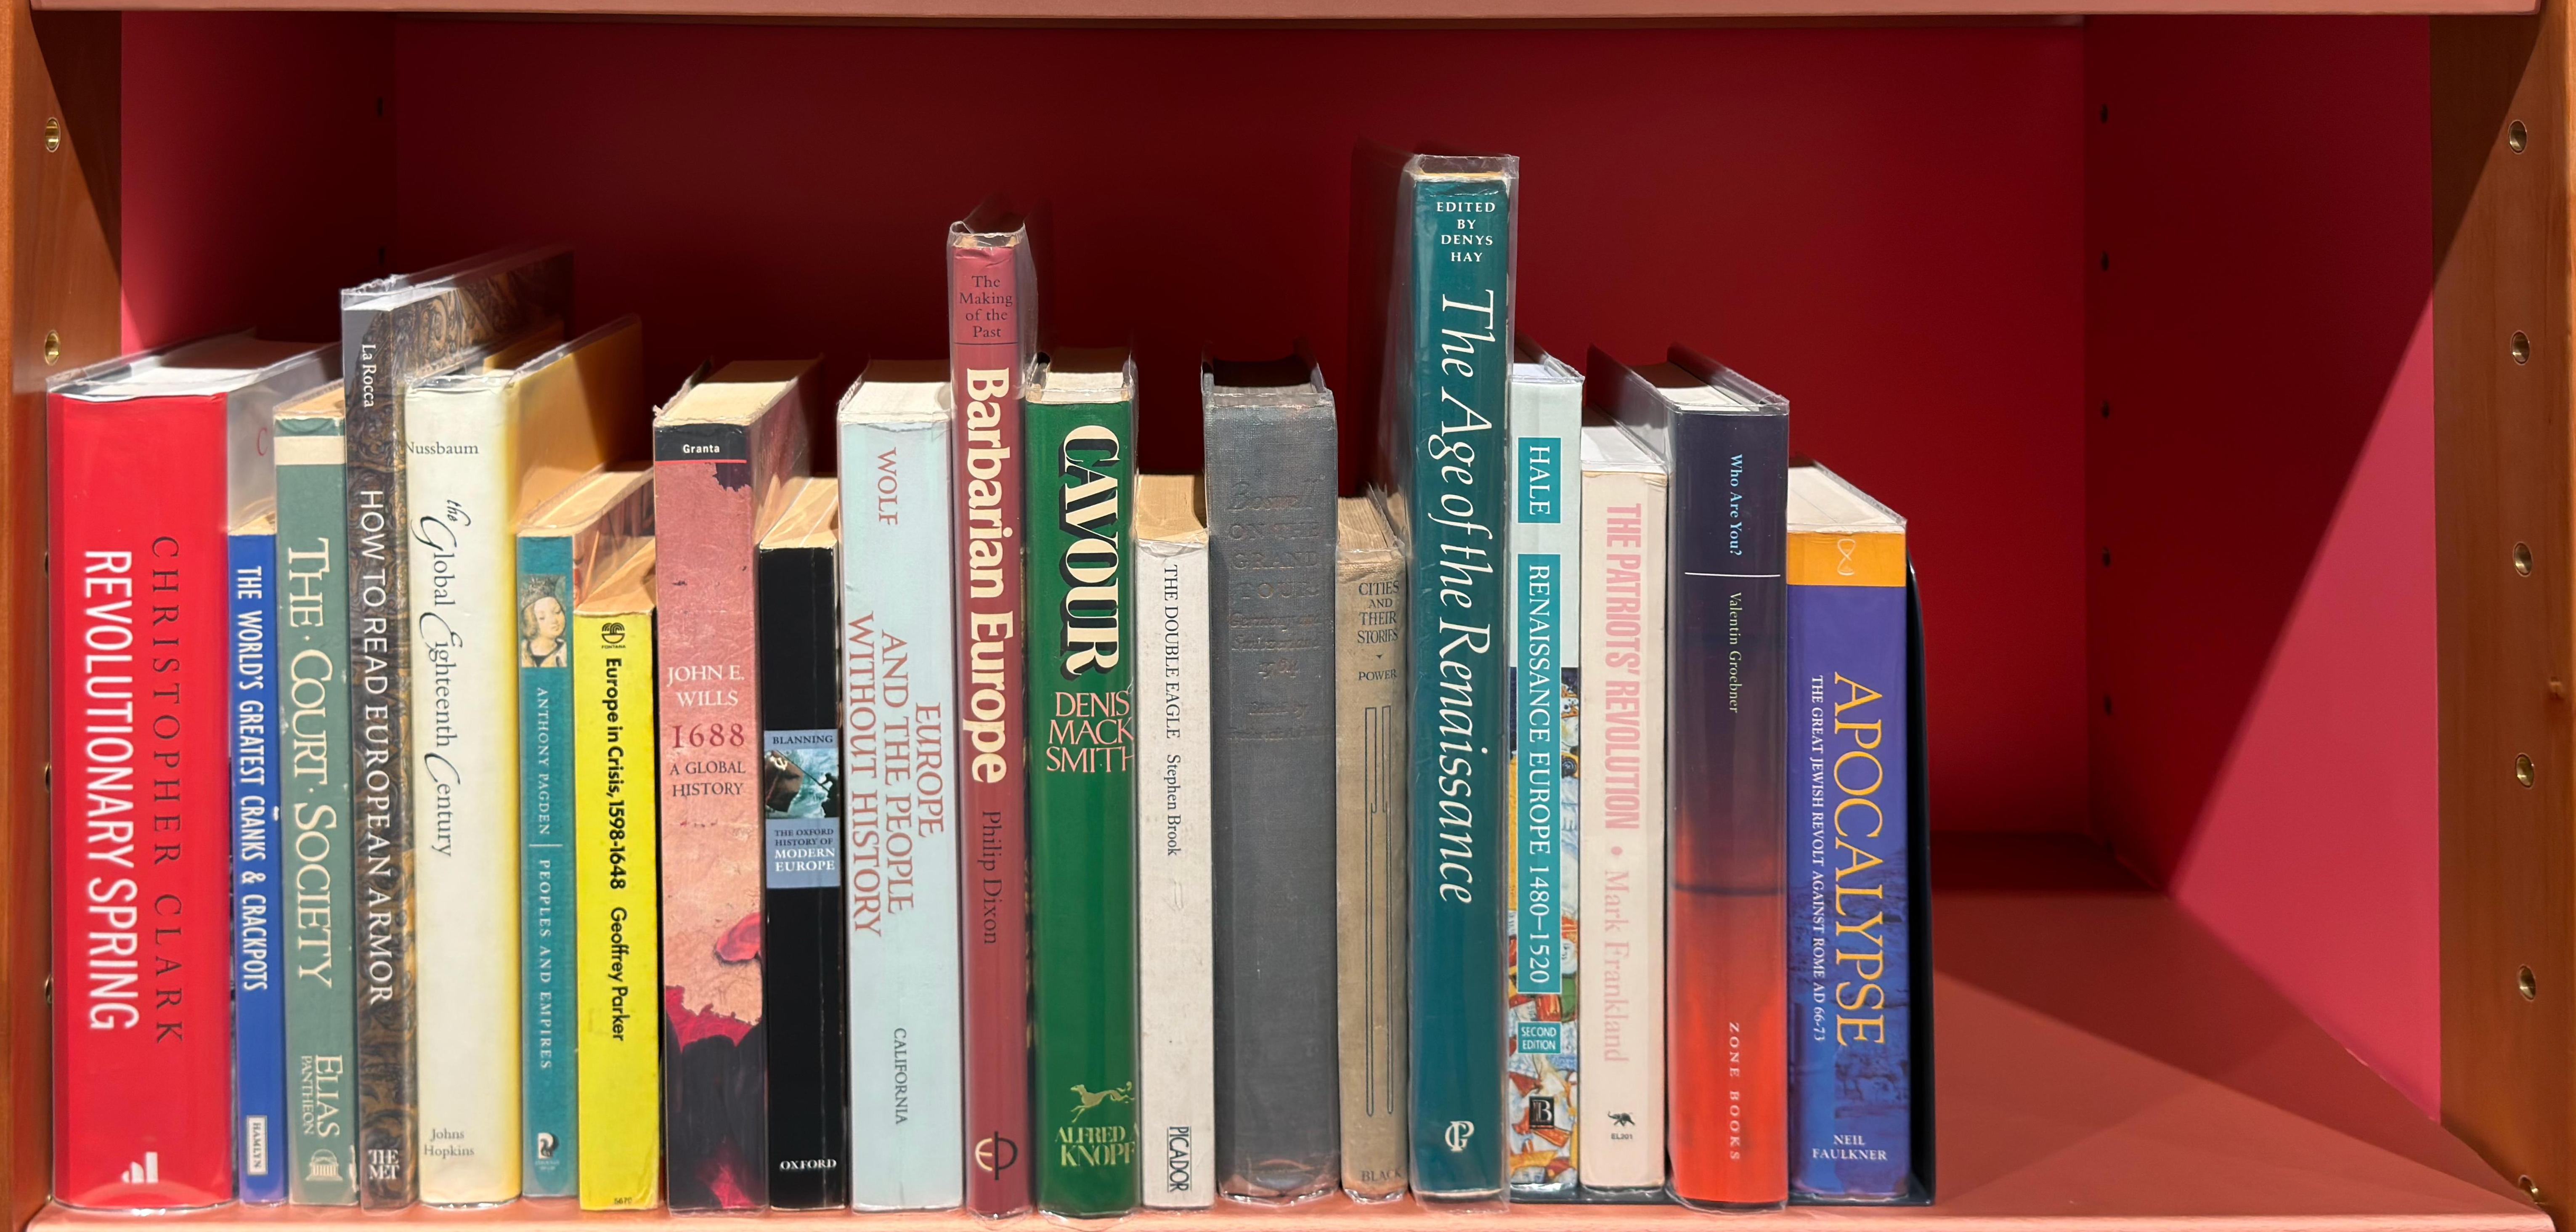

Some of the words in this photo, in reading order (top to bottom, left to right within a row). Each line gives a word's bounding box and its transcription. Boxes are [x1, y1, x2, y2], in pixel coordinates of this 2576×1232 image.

[1437, 202, 1495, 213] EDITED
[1457, 219, 1476, 229] BY
[1441, 235, 1493, 246] DENYS
[1450, 252, 1483, 262] HAY
[959, 292, 1013, 307] Making
[971, 275, 1001, 287] The
[966, 309, 982, 321] of
[986, 309, 1008, 321] the
[972, 326, 1002, 337] Past
[1441, 289, 1496, 378] The
[362, 344, 376, 362] La
[362, 364, 377, 408] Rocca
[406, 441, 479, 455] Nussbaum
[682, 444, 720, 454] Granta
[1428, 385, 1492, 485] Age
[877, 447, 898, 526] WOLF
[966, 367, 1013, 598] Barbarian
[1529, 445, 1551, 516] HALE
[1730, 454, 1743, 487] Who
[361, 491, 385, 561] HOW
[446, 499, 471, 526] the
[1428, 494, 1494, 540] of
[1606, 503, 1642, 548] THE
[1730, 491, 1743, 518] Are
[411, 516, 457, 606] Global
[1059, 425, 1120, 680] CAVOUR
[1233, 550, 1318, 570] GRAND
[1730, 522, 1742, 556] You?
[237, 566, 263, 600] THE
[288, 538, 329, 628] THE
[363, 569, 386, 607] TO
[1164, 564, 1178, 601] THE
[1358, 580, 1399, 595] CITIES
[1439, 543, 1494, 608] the
[1358, 611, 1397, 626] THEIR
[1368, 598, 1393, 608] AND
[1605, 554, 1642, 676] PATRIOTS'
[1729, 592, 1743, 645] Valentin
[238, 611, 264, 690] WORLD'S
[364, 618, 388, 694] READ
[1165, 606, 1179, 677] DOUBLE
[1357, 630, 1398, 644] STORIES
[1528, 564, 1551, 743] RENAISSANCE
[419, 612, 463, 747] Eighteenth
[602, 658, 622, 722] Europe
[667, 665, 723, 687] JOHN
[729, 665, 745, 681] E.
[848, 611, 878, 778] WITHOUT
[881, 629, 909, 708] AND
[1358, 669, 1397, 681] POWER
[1729, 651, 1743, 714] Groebner
[1812, 675, 1823, 703] THE
[84, 552, 134, 868] REVOLUTIONARY
[152, 536, 180, 865] CHRISTOPHER
[290, 650, 333, 786] COURT
[676, 690, 738, 707] WILLS
[963, 611, 1013, 783] Europe
[1055, 690, 1130, 717] DENIS
[1165, 682, 1181, 738] EAGLE
[239, 701, 265, 784] GREATEST
[537, 688, 549, 767] ANTHONY
[606, 727, 623, 742] in
[672, 723, 745, 748] 1688
[772, 735, 833, 745] BLANNING
[883, 716, 912, 786] THE
[1048, 717, 1134, 745] MACK
[1812, 707, 1823, 754] GREAT
[606, 746, 624, 797] Crisis,
[669, 763, 681, 775] A
[685, 761, 746, 775] GLOBAL
[915, 702, 944, 838] EUROPE
[1438, 616, 1490, 903] Renaissance
[1605, 680, 1641, 829] REVOLUTION
[366, 704, 390, 877] EUROPEAN
[424, 752, 461, 858] Century
[538, 773, 550, 836] PAGDEN
[672, 783, 744, 797] HISTORY
[1164, 754, 1181, 810] Stephen
[1528, 752, 1551, 855] EUROPE
[1809, 757, 1824, 807] JEWISH
[240, 795, 266, 861] CRANKS
[609, 800, 626, 889] 1598-1648
[775, 838, 818, 847] HISTORY
[775, 847, 835, 859] MODERN
[885, 792, 914, 914] PEOPLE
[977, 810, 1002, 871] Philip
[1167, 815, 1181, 856] Brook
[1812, 812, 1824, 866] REVOLT
[241, 871, 267, 884] &
[775, 860, 835, 872] EUROPE
[852, 789, 882, 937] HISTORY
[1834, 672, 1885, 1046] APOCALYPSE
[294, 803, 337, 989] SOCIETY
[539, 860, 551, 937] PEOPLES
[982, 879, 1003, 945] Dixon
[1604, 870, 1629, 932] Mark
[1812, 870, 1825, 934] AGAINST
[88, 877, 139, 1030] SPRING
[242, 894, 268, 990] CRACKPOTS
[369, 888, 394, 1004] ARMOR
[539, 945, 551, 983] AND
[608, 907, 629, 982] Geoffrey
[1813, 937, 1825, 978] ROME
[154, 894, 183, 1044] CLARK
[1813, 982, 1825, 1004] AD
[611, 987, 630, 1041] Parker
[1603, 941, 1629, 1062] Frankland
[540, 991, 552, 1069] EMPIRES
[1521, 1026, 1557, 1037] SECOND
[1522, 1040, 1556, 1050] EDITION
[1729, 1022, 1740, 1077] ZONE
[300, 1055, 314, 1135] PANTHEON
[315, 1054, 343, 1137] ELIAS
[894, 1027, 909, 1125] CALIFORNIA
[251, 1122, 261, 1168] HAMLYN
[423, 1144, 475, 1159] Hopkins
[430, 1128, 464, 1142] Johns
[1054, 1126, 1126, 1144] ALFRED
[1729, 1091, 1740, 1161] BOOKS
[1833, 1134, 1865, 1146] NEIL
[368, 1150, 398, 1165] THE
[369, 1165, 400, 1180] MET
[779, 1158, 837, 1171] OXFORD
[1061, 1141, 1135, 1166] KNOPF
[1169, 1126, 1189, 1192] PICADOR
[1361, 1168, 1402, 1182] BLACK
[1812, 1148, 1888, 1161] FAULKNER
